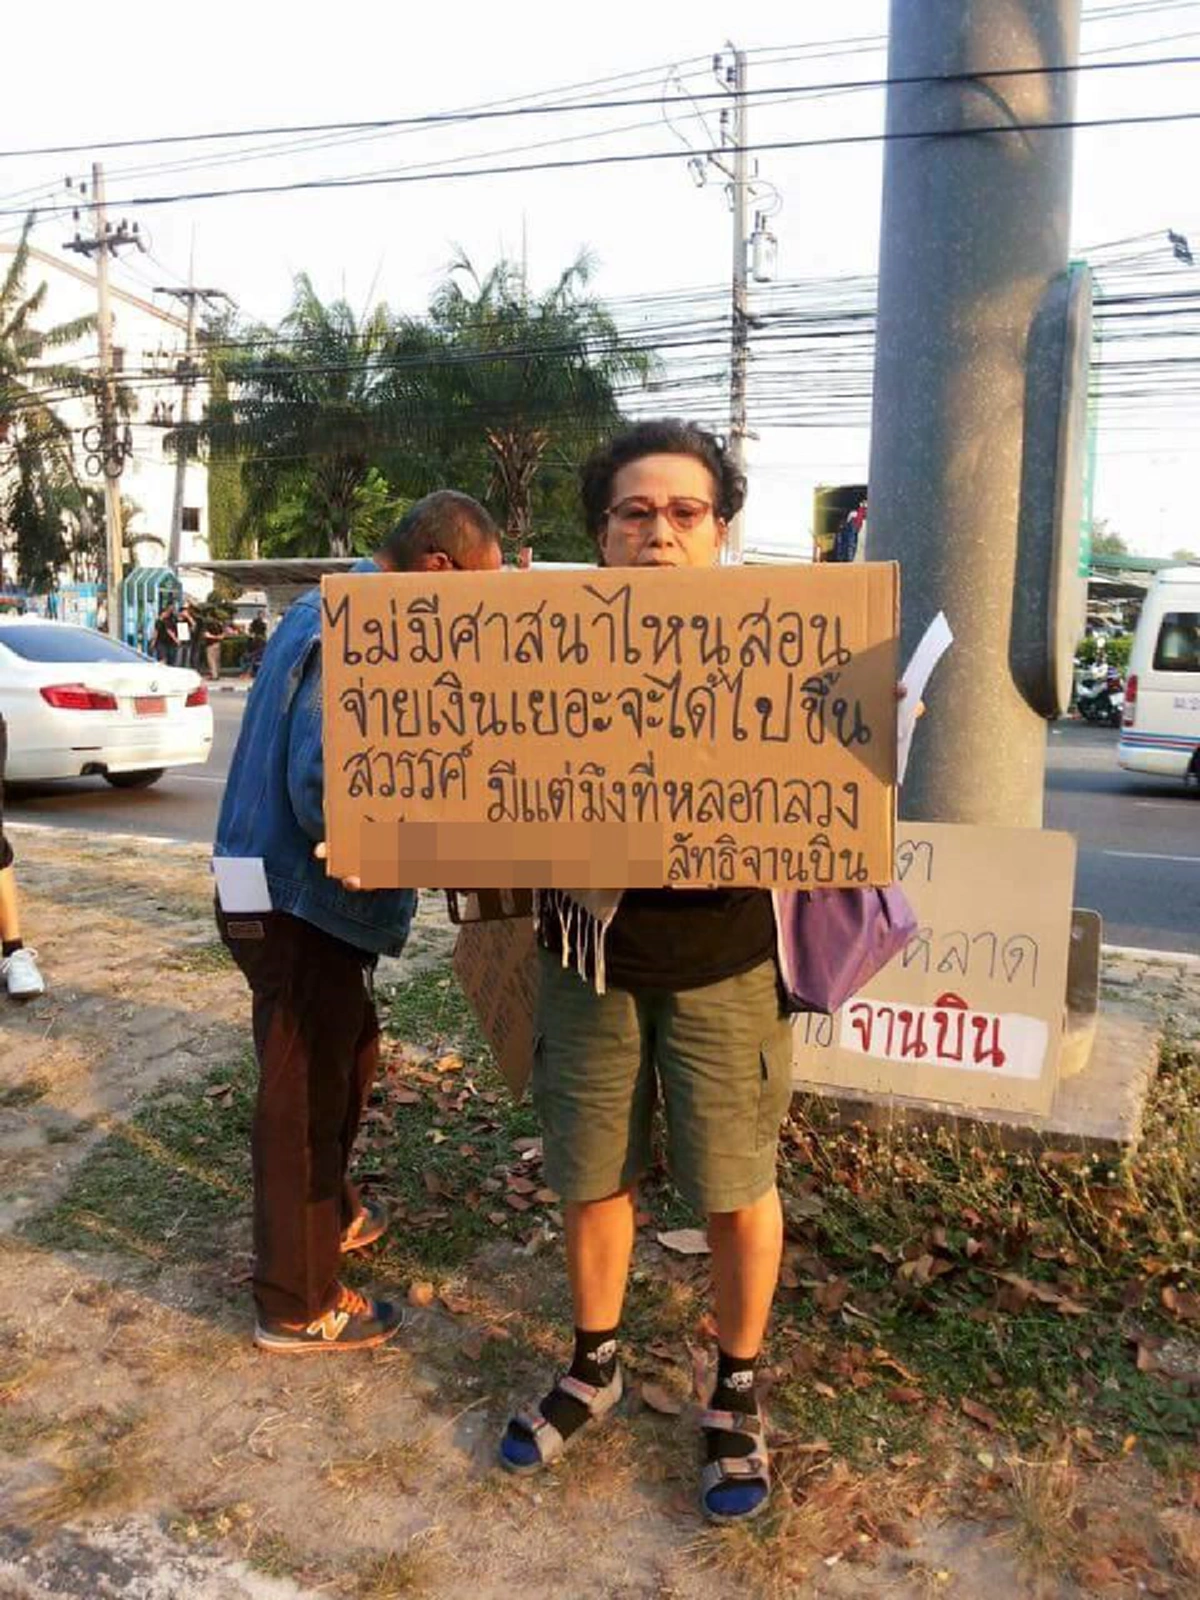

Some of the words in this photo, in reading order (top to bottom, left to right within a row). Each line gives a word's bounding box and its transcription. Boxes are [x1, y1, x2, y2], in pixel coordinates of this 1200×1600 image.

[321, 583, 852, 668] ไม่มีศาสนาไหนสอน
[668, 832, 868, 882] ลัทธิจานบิน
[849, 992, 1005, 1067] จานบิน
